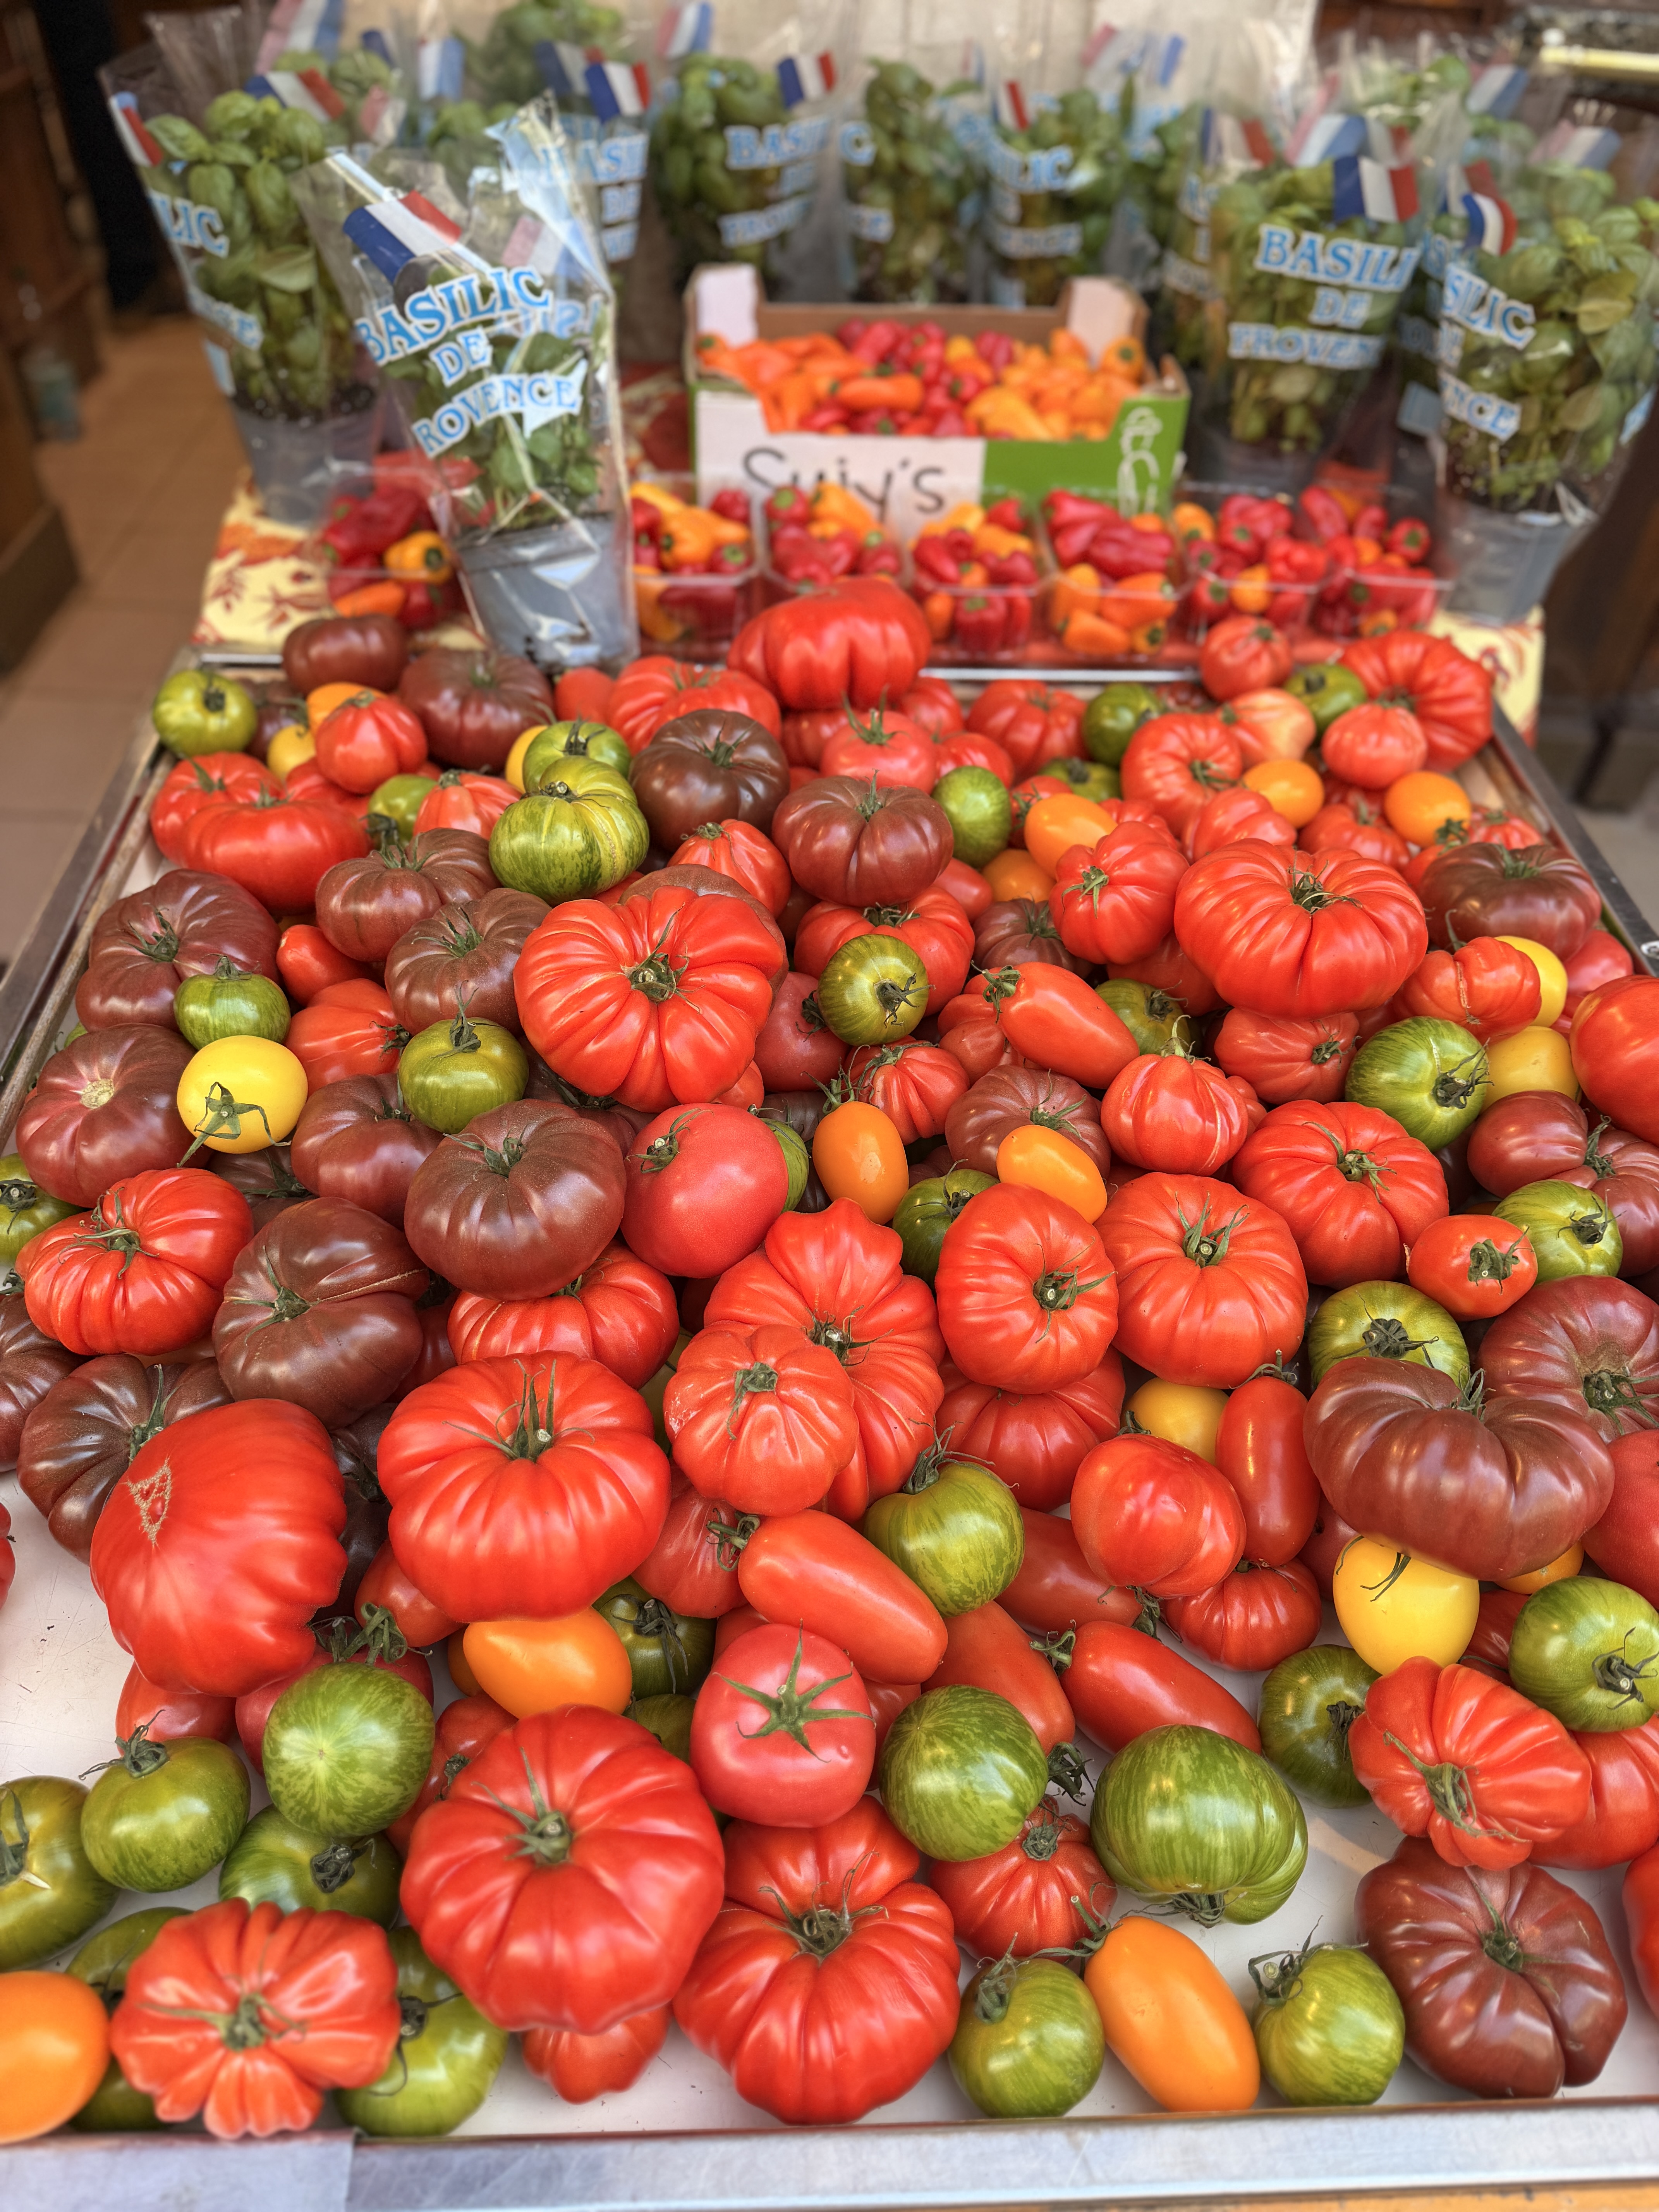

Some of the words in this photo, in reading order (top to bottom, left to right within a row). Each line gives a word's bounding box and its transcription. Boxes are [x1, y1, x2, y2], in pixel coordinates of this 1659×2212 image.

[1258, 226, 1418, 288] BASILI
[352, 267, 551, 364] BASILIC
[1311, 290, 1371, 327] DE
[1443, 271, 1536, 345] SILIC
[433, 330, 489, 383] DE
[412, 374, 582, 456] ROVENCE
